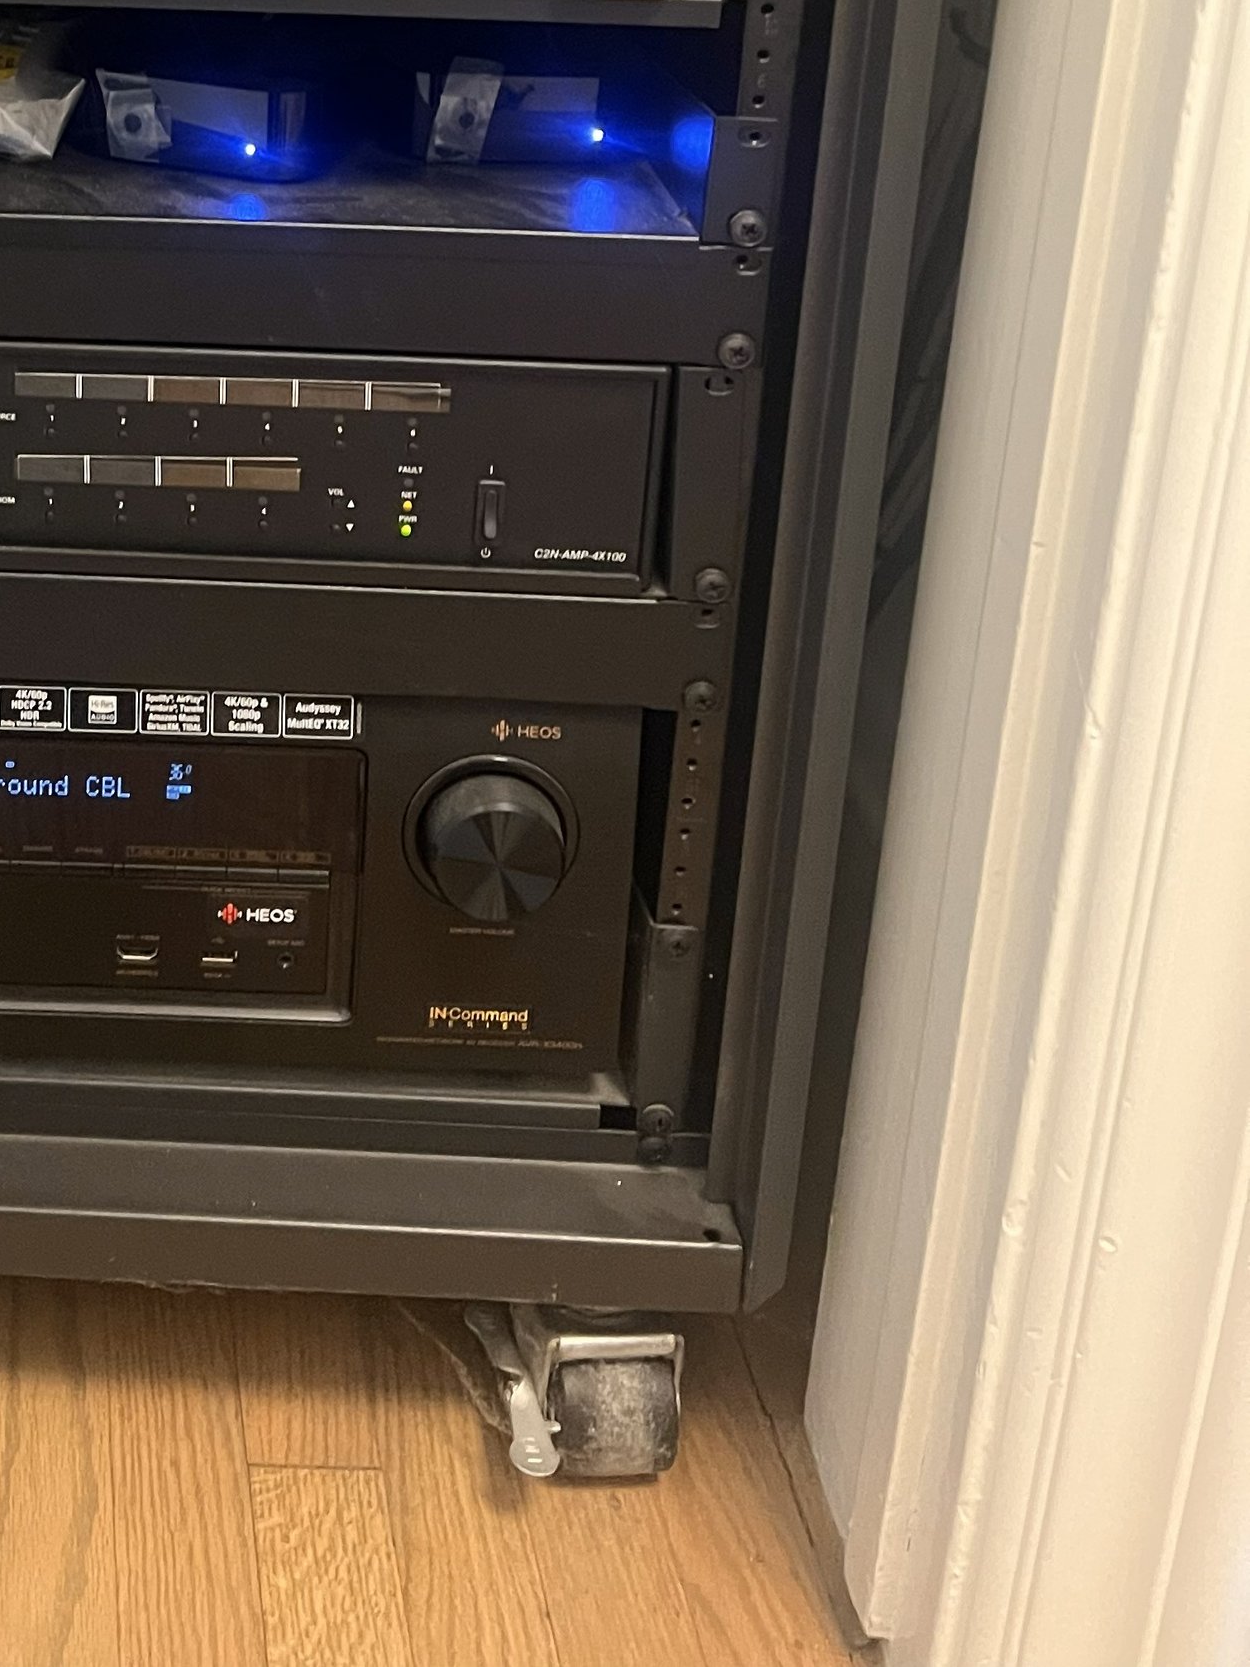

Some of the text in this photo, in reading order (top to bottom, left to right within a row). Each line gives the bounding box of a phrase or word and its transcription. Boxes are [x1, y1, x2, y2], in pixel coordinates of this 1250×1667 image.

[328, 488, 344, 497] VOL
[534, 548, 627, 563] C2N-AMP-4X100
[260, 697, 269, 708] &
[517, 724, 561, 739] HEOS
[86, 776, 131, 798] CBL
[246, 908, 295, 923] HEOS
